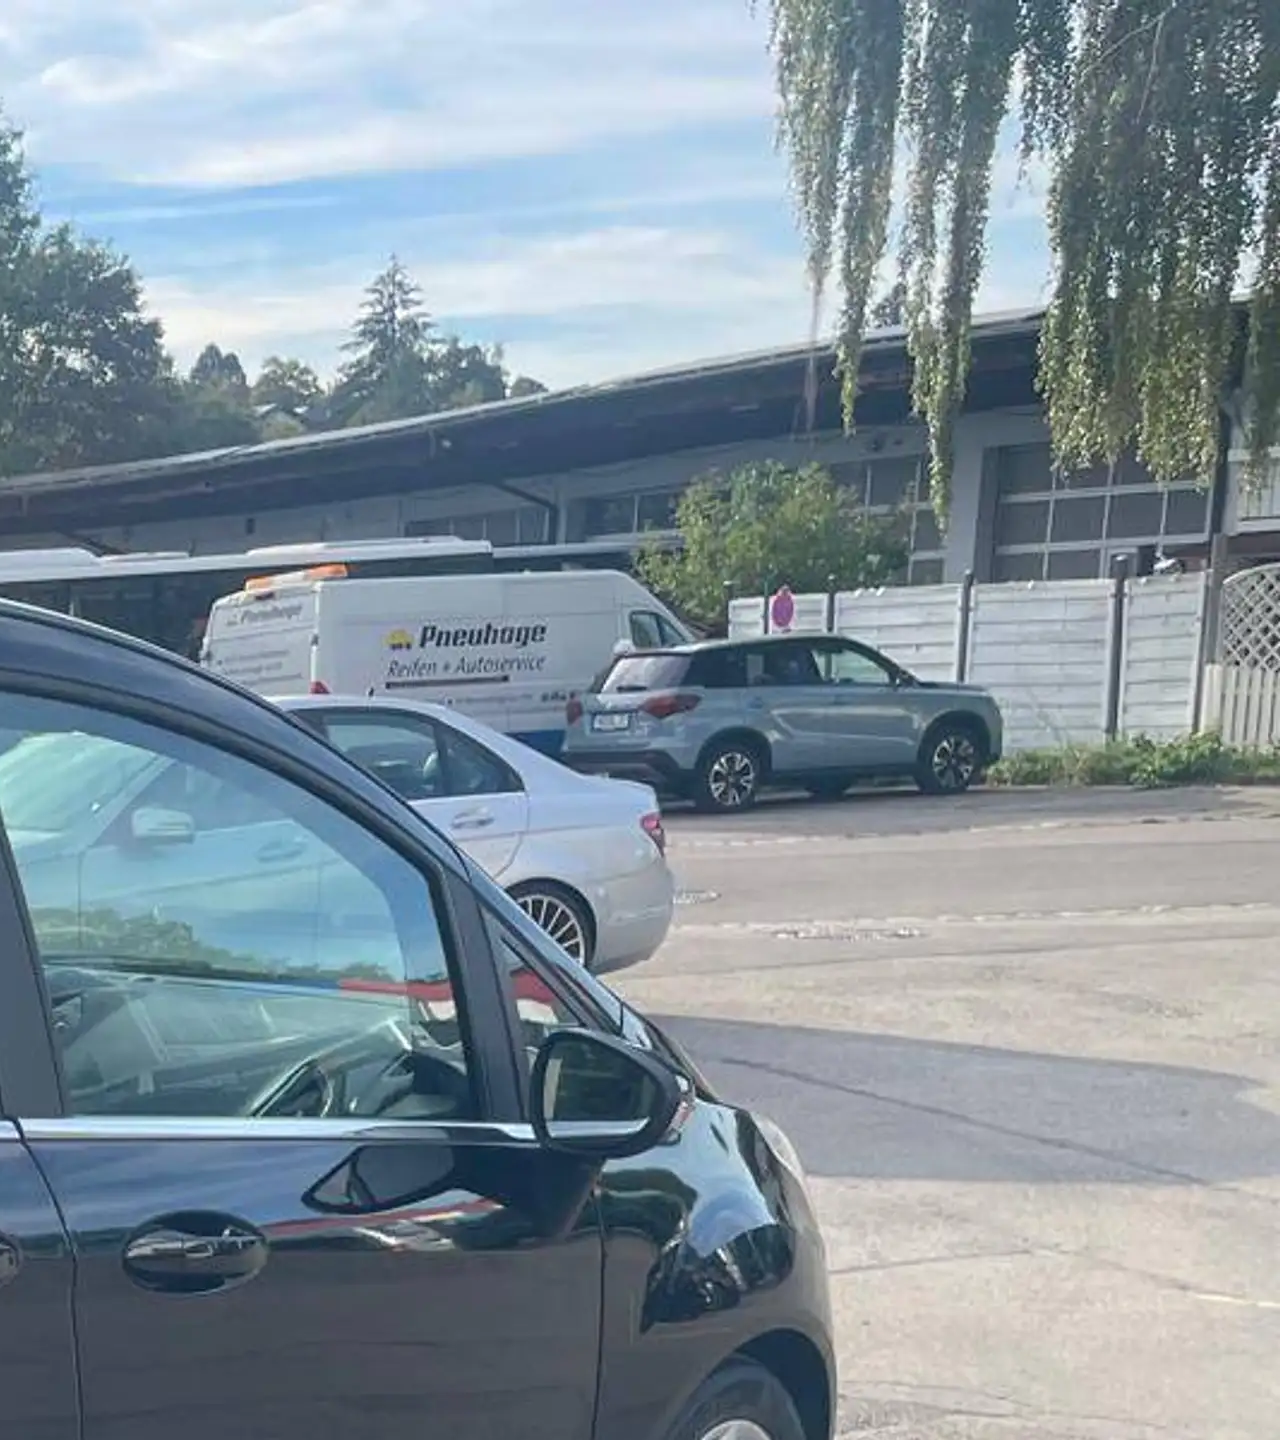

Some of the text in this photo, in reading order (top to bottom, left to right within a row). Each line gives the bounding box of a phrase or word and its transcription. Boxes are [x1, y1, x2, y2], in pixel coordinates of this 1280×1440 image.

[419, 624, 547, 648] Pneuhage
[388, 657, 437, 677] Reifen
[453, 656, 546, 675] Autoservice
